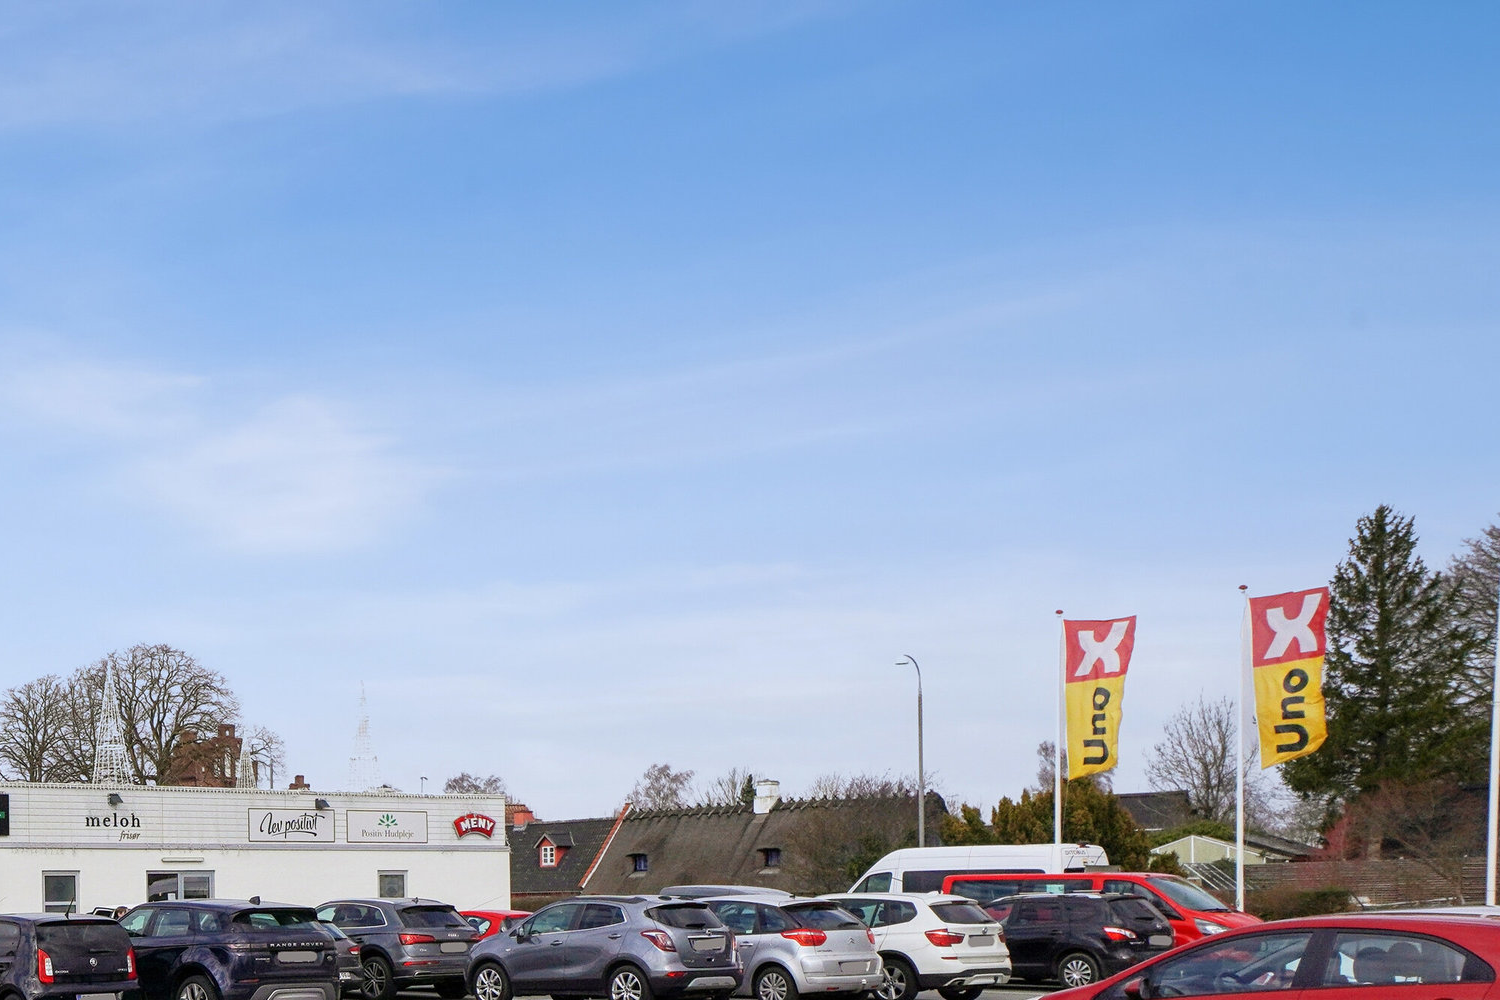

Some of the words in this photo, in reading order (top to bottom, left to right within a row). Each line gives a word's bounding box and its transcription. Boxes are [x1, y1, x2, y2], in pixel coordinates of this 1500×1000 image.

[1274, 668, 1309, 753] Uno
[1083, 687, 1111, 765] Uno
[85, 812, 141, 828] meloh
[460, 818, 494, 832] MENY
[119, 830, 141, 842] frisør
[361, 829, 383, 838] Positiv
[384, 829, 415, 840] Hudpleje
